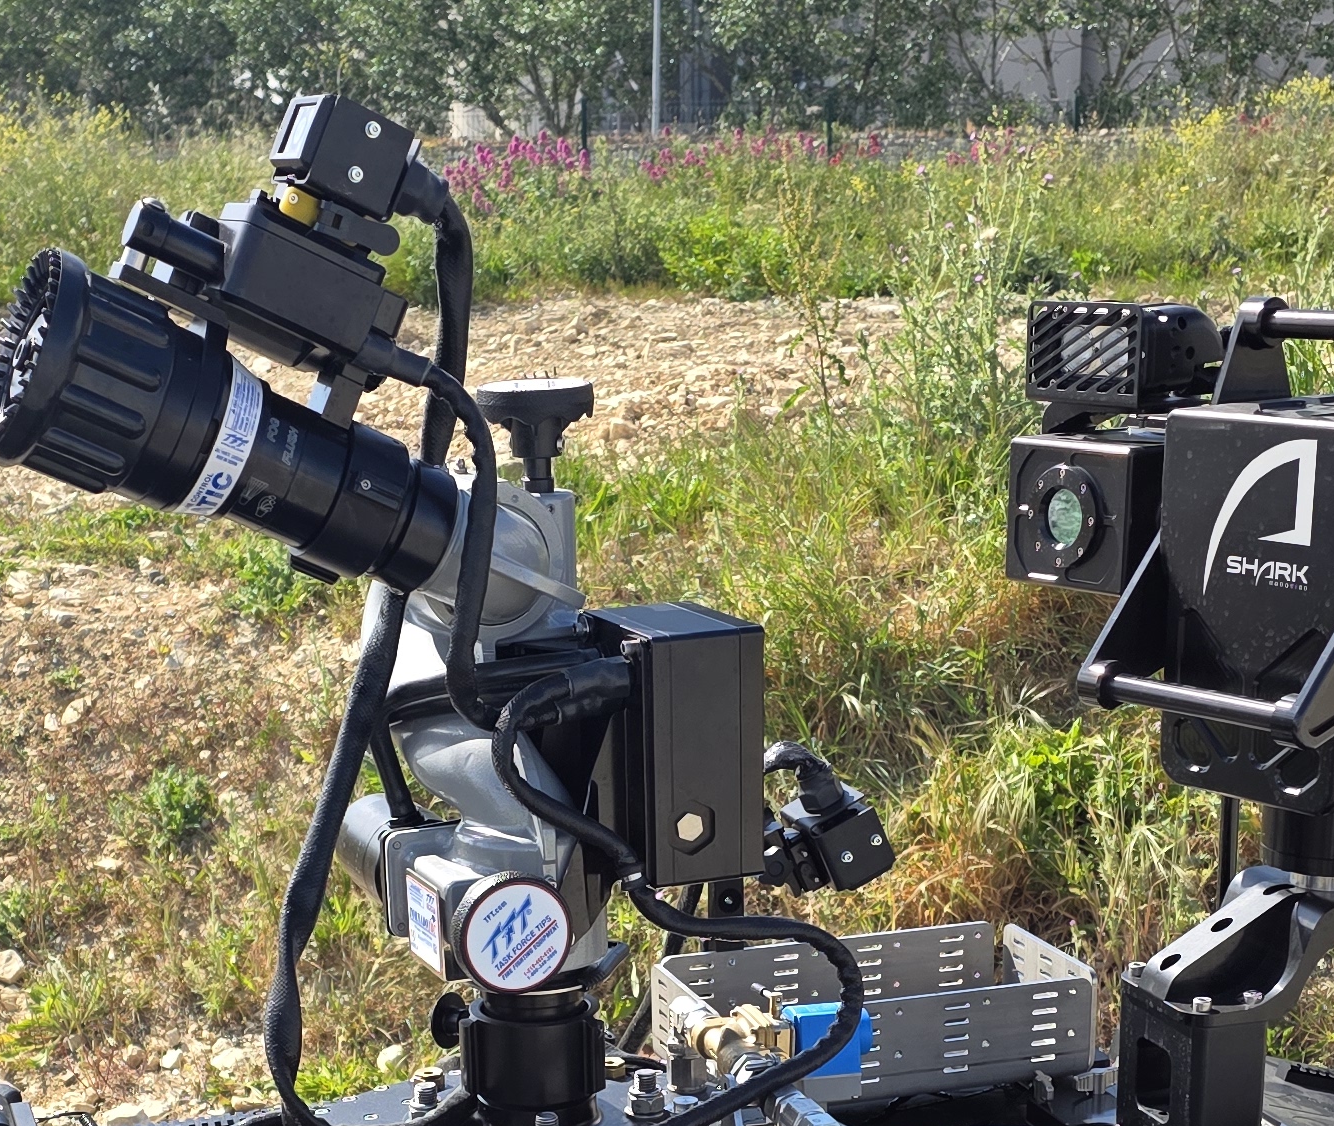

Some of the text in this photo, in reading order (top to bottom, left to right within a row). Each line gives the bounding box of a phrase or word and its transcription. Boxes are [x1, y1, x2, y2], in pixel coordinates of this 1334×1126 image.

[267, 417, 280, 443] FOG
[190, 472, 215, 503] CONTROL
[1226, 555, 1309, 586] SHARK
[482, 900, 508, 924] TFT.com
[480, 893, 533, 965] TFT
[494, 914, 552, 971] TASK FORCE TIPS
[500, 966, 514, 981] FIRE
[532, 922, 560, 950] EQUIPMENT
